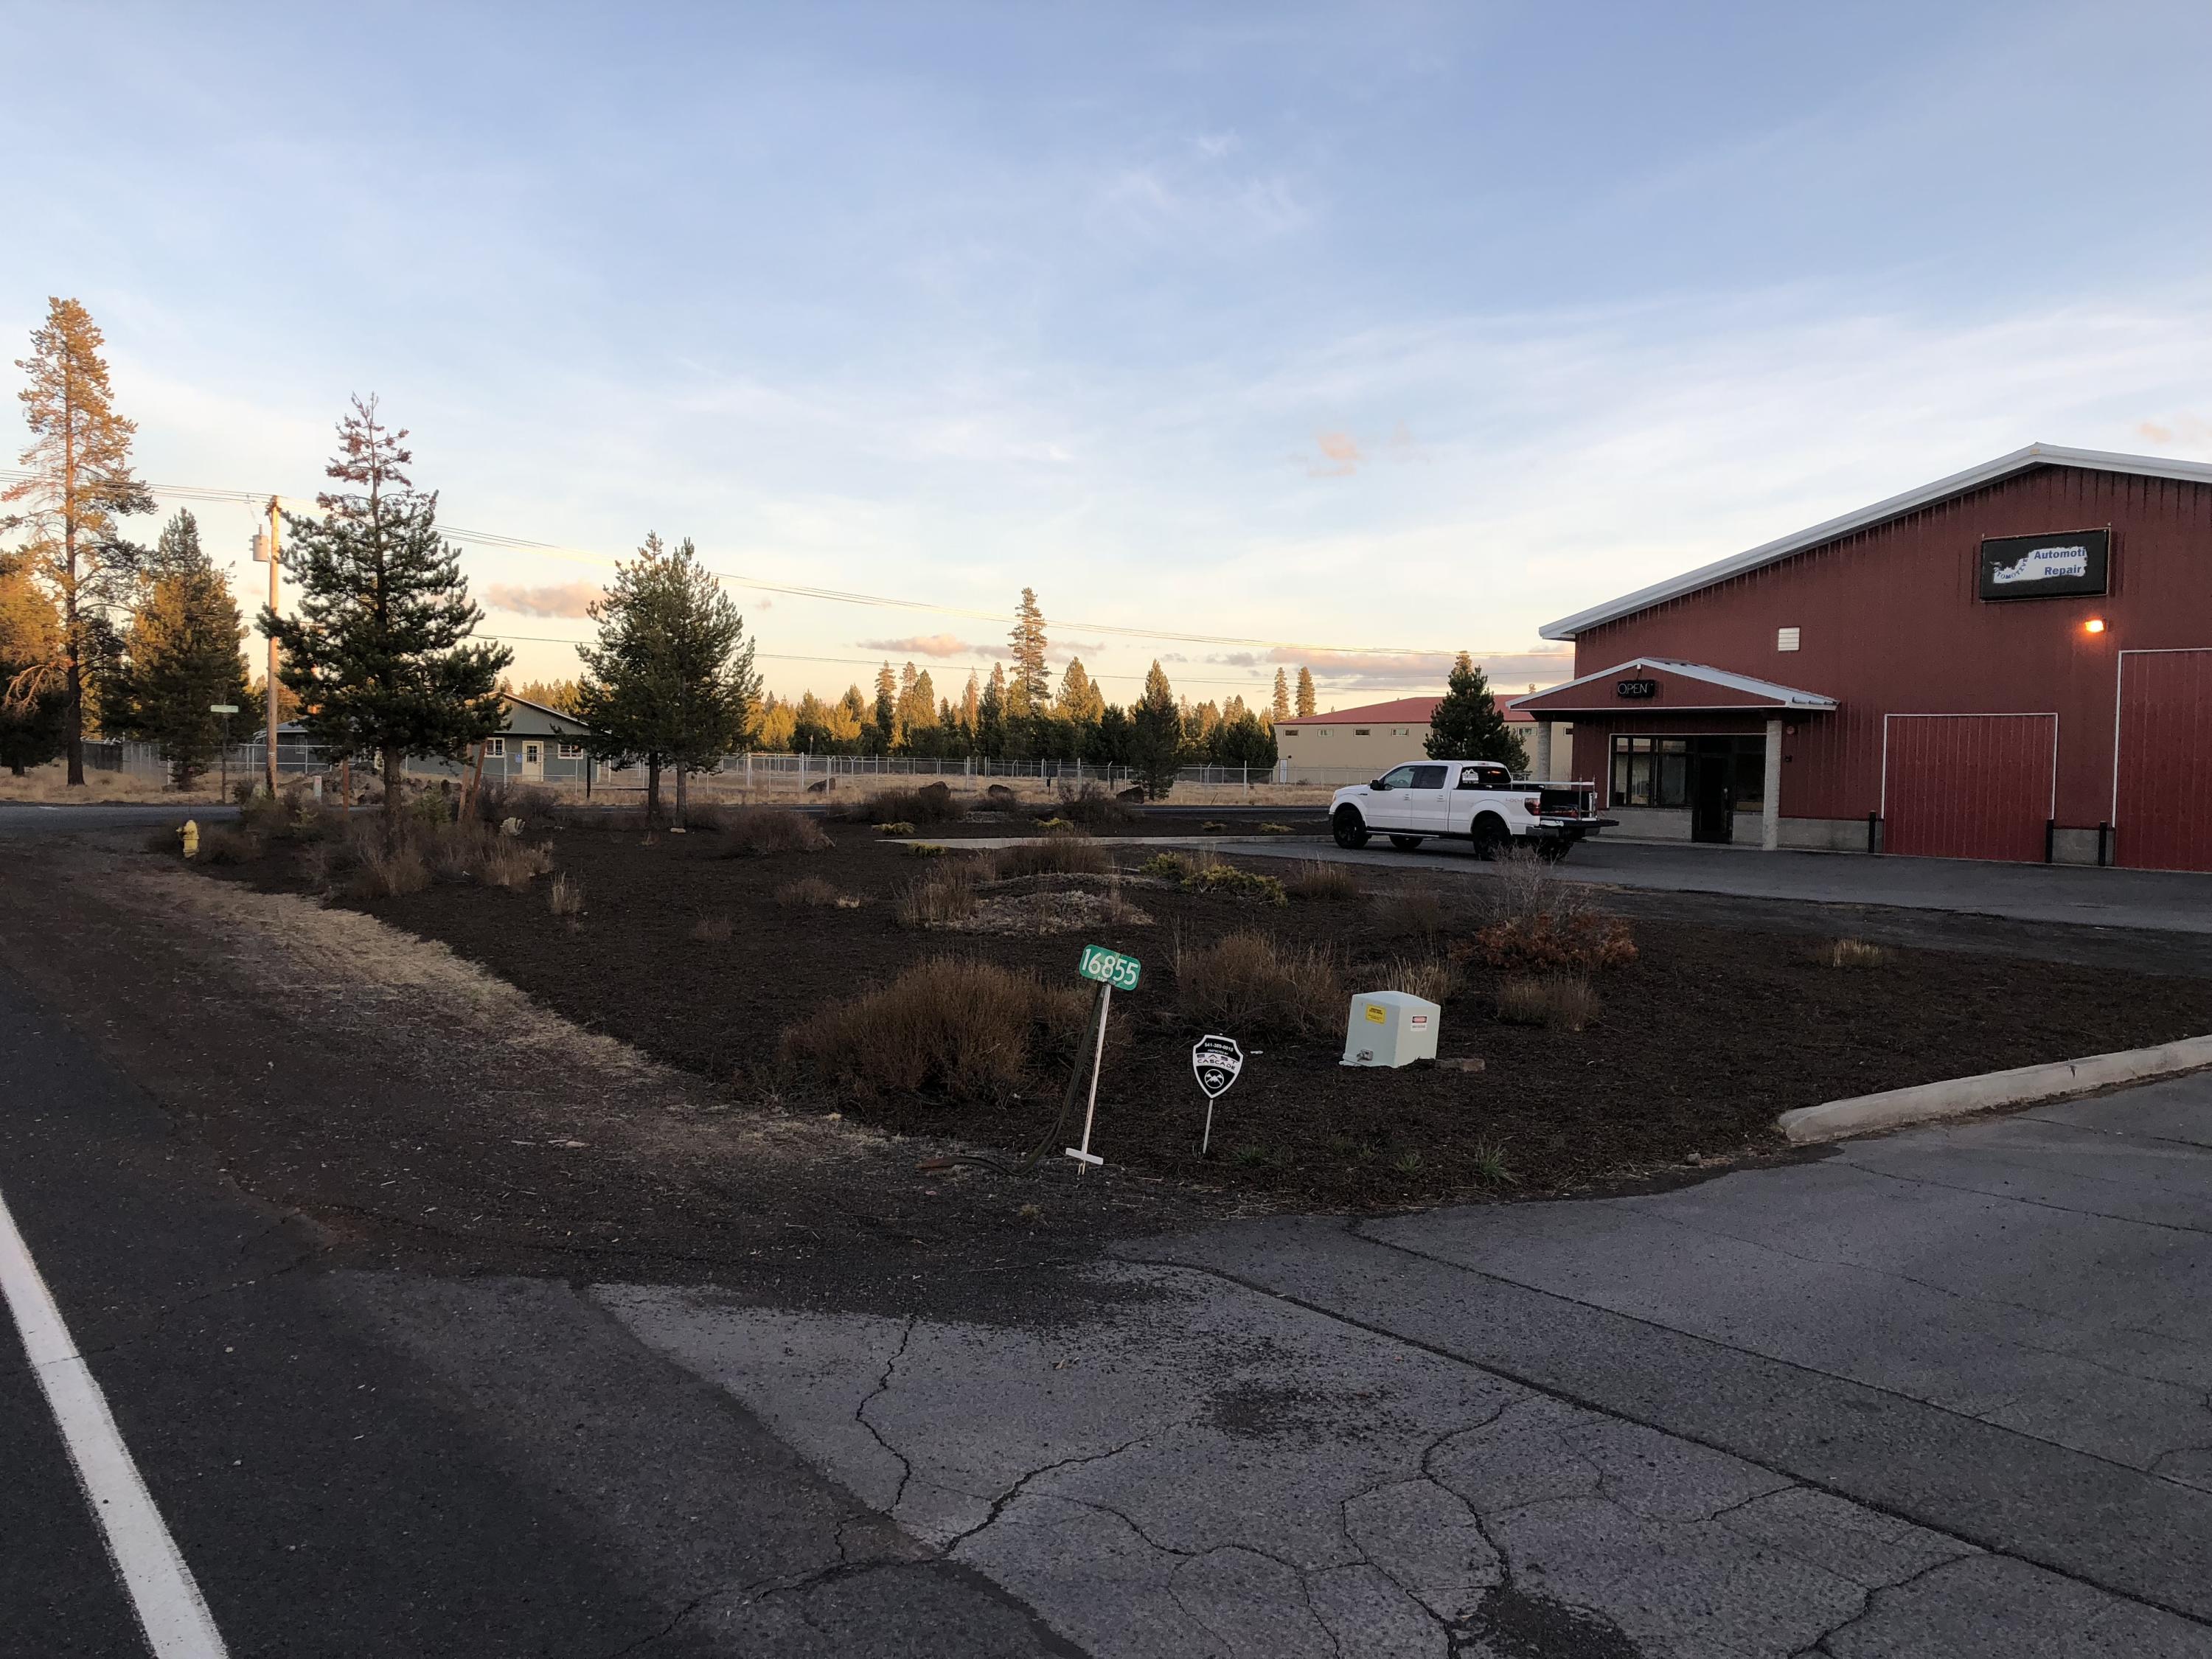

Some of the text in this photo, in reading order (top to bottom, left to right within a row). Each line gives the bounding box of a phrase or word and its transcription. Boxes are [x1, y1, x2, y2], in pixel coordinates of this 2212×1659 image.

[2045, 565, 2081, 577] Repair
[1618, 683, 1648, 695] OPEN
[1082, 948, 1138, 985] 16855
[1197, 1054, 1238, 1064] EAST
[1197, 1060, 1236, 1071] CASCADE
